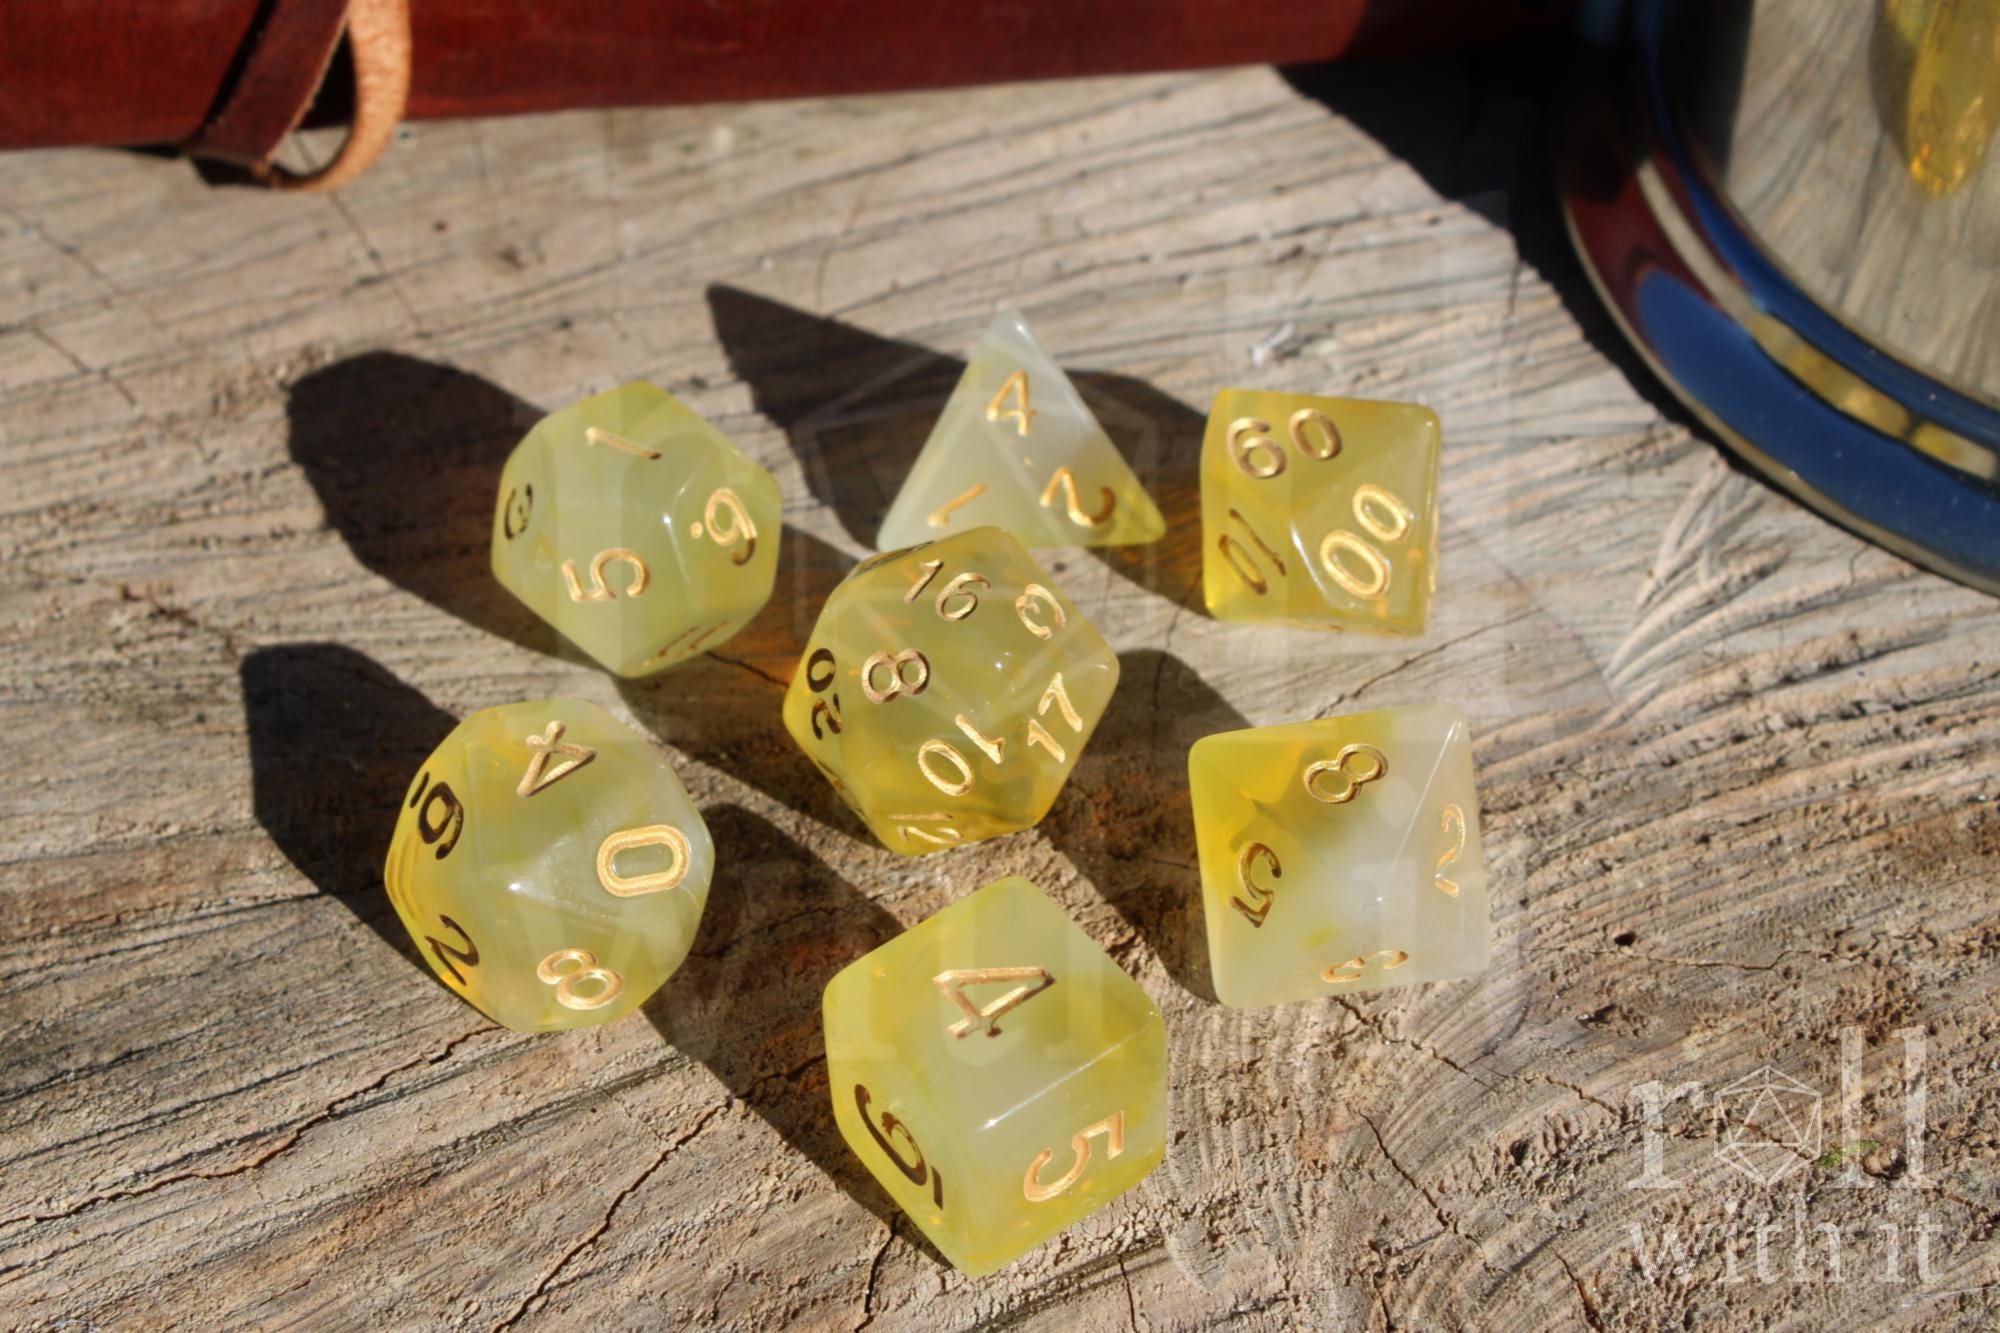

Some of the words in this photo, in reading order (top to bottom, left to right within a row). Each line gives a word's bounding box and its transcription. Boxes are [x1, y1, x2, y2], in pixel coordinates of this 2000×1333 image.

[987, 370, 1038, 436] 4
[1226, 408, 1342, 479] 60
[1040, 467, 1116, 527] 2
[562, 548, 649, 602] 5
[1320, 484, 1410, 599] 00
[905, 559, 991, 620] 16
[862, 649, 930, 704] 8
[1028, 672, 1083, 762] 17
[516, 720, 597, 797] 4
[918, 713, 1005, 796] 10
[1303, 743, 1389, 804] 8
[1230, 842, 1281, 928] 5
[1434, 803, 1466, 898] 2
[425, 914, 479, 986] 2
[537, 948, 623, 1010] 8
[933, 966, 1056, 1041] 4
[1023, 1110, 1125, 1202] 5
